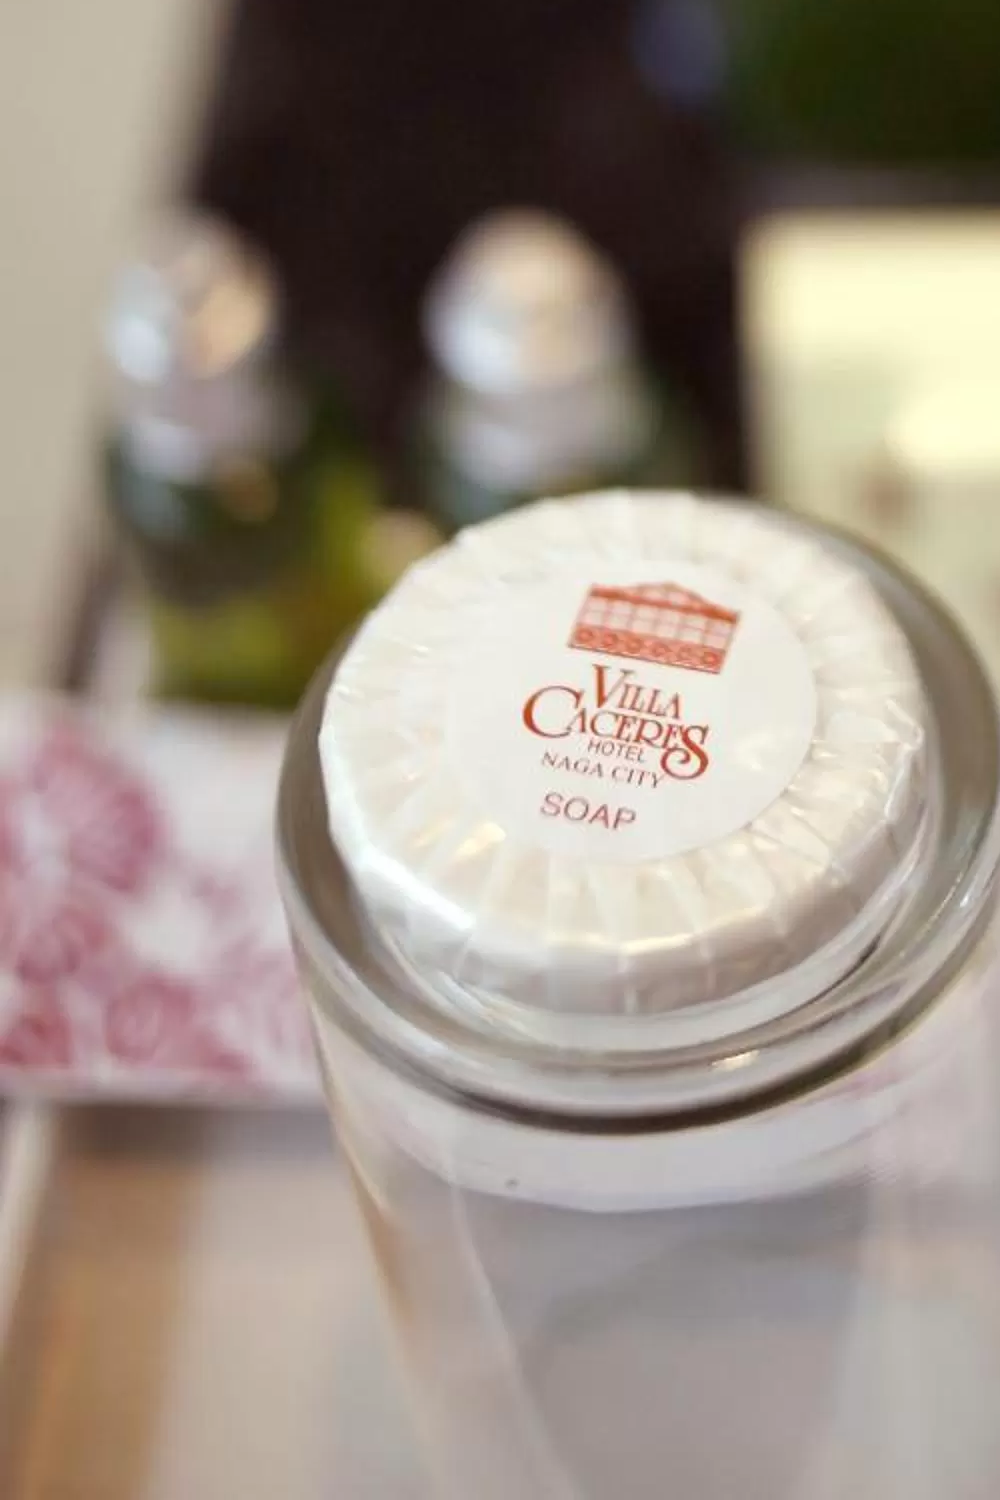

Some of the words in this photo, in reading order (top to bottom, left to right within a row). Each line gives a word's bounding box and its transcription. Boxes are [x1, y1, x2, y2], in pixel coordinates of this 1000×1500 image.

[592, 663, 682, 719] VILLA
[522, 685, 709, 780] CACERES
[587, 739, 647, 764] HOTEL
[541, 751, 604, 778] NAGA
[611, 766, 666, 789] CITY
[540, 792, 637, 831] SOAP
